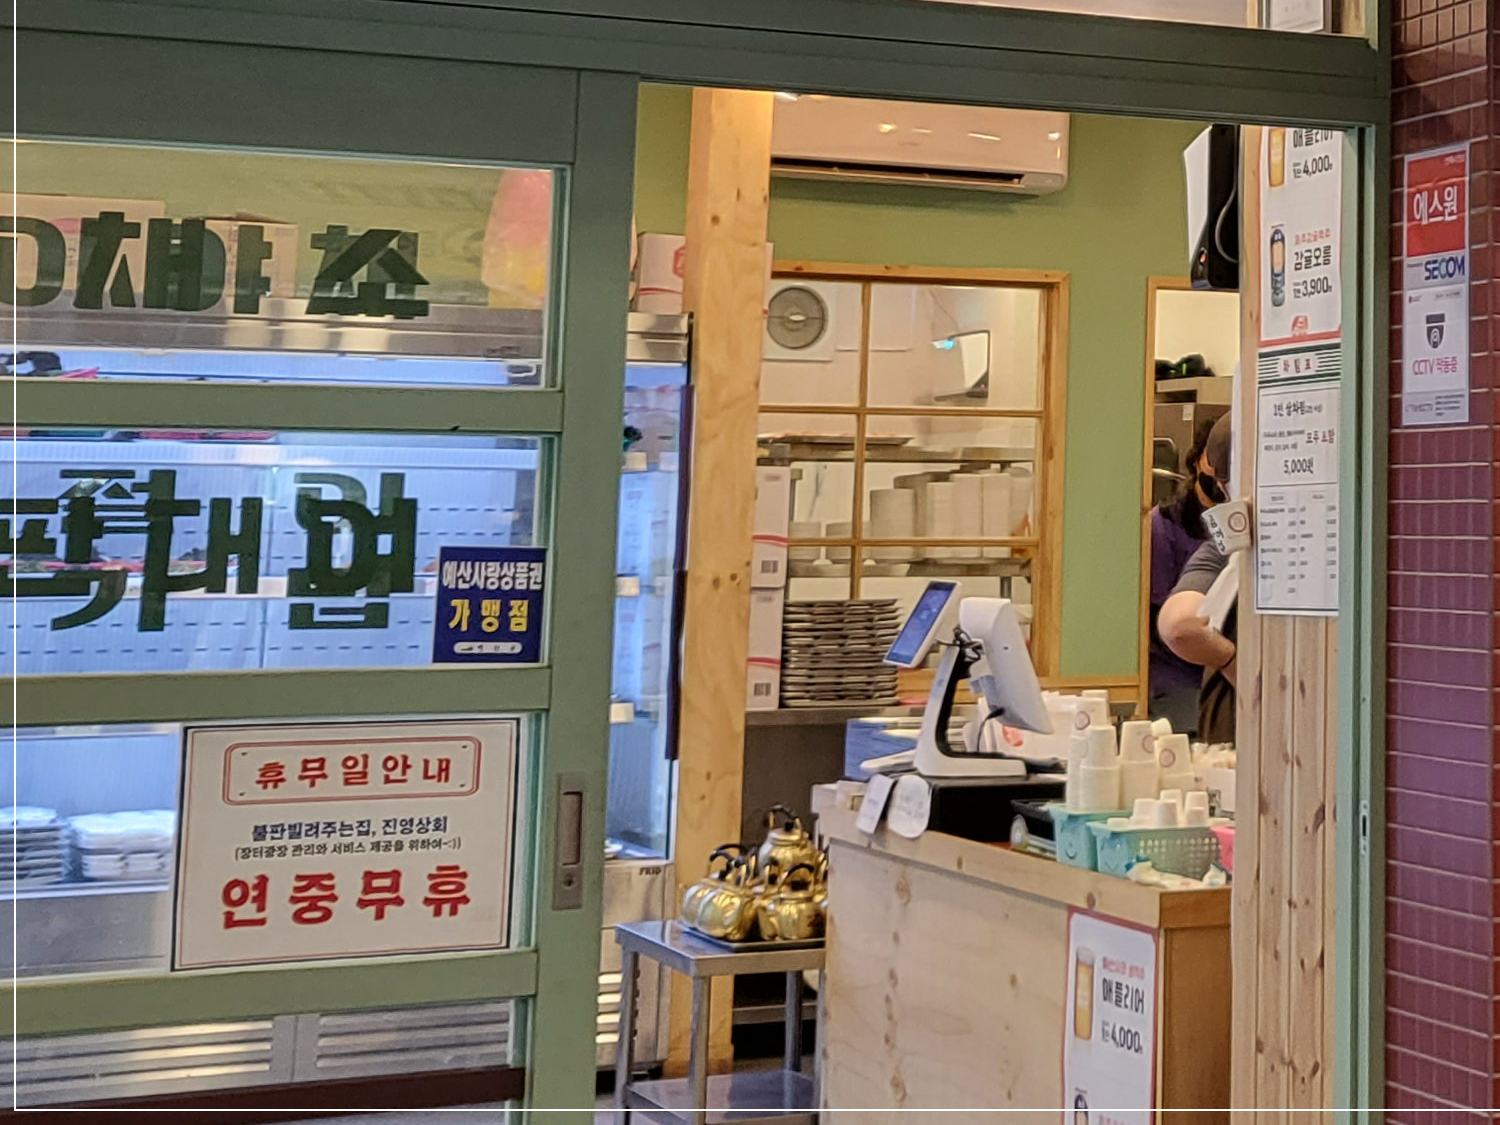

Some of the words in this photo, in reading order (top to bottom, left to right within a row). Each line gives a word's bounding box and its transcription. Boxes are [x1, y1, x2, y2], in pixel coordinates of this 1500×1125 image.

[1413, 186, 1458, 225] 에스원
[1294, 245, 1331, 271] 감귤오름
[1424, 255, 1465, 281] SECOM
[1412, 358, 1435, 375] CCTV
[442, 560, 544, 591] 예산사랑상품권
[448, 598, 529, 633] 가맹점
[255, 753, 452, 790] 휴무일안내
[251, 819, 376, 842] 불판빌려주는집,
[381, 815, 448, 836] 진영상회
[291, 842, 327, 857] 관리와
[331, 841, 366, 854] 서비스
[369, 839, 404, 853] 제공을
[221, 865, 471, 930] 연중무휴
[1102, 977, 1145, 1015] 애플리어
